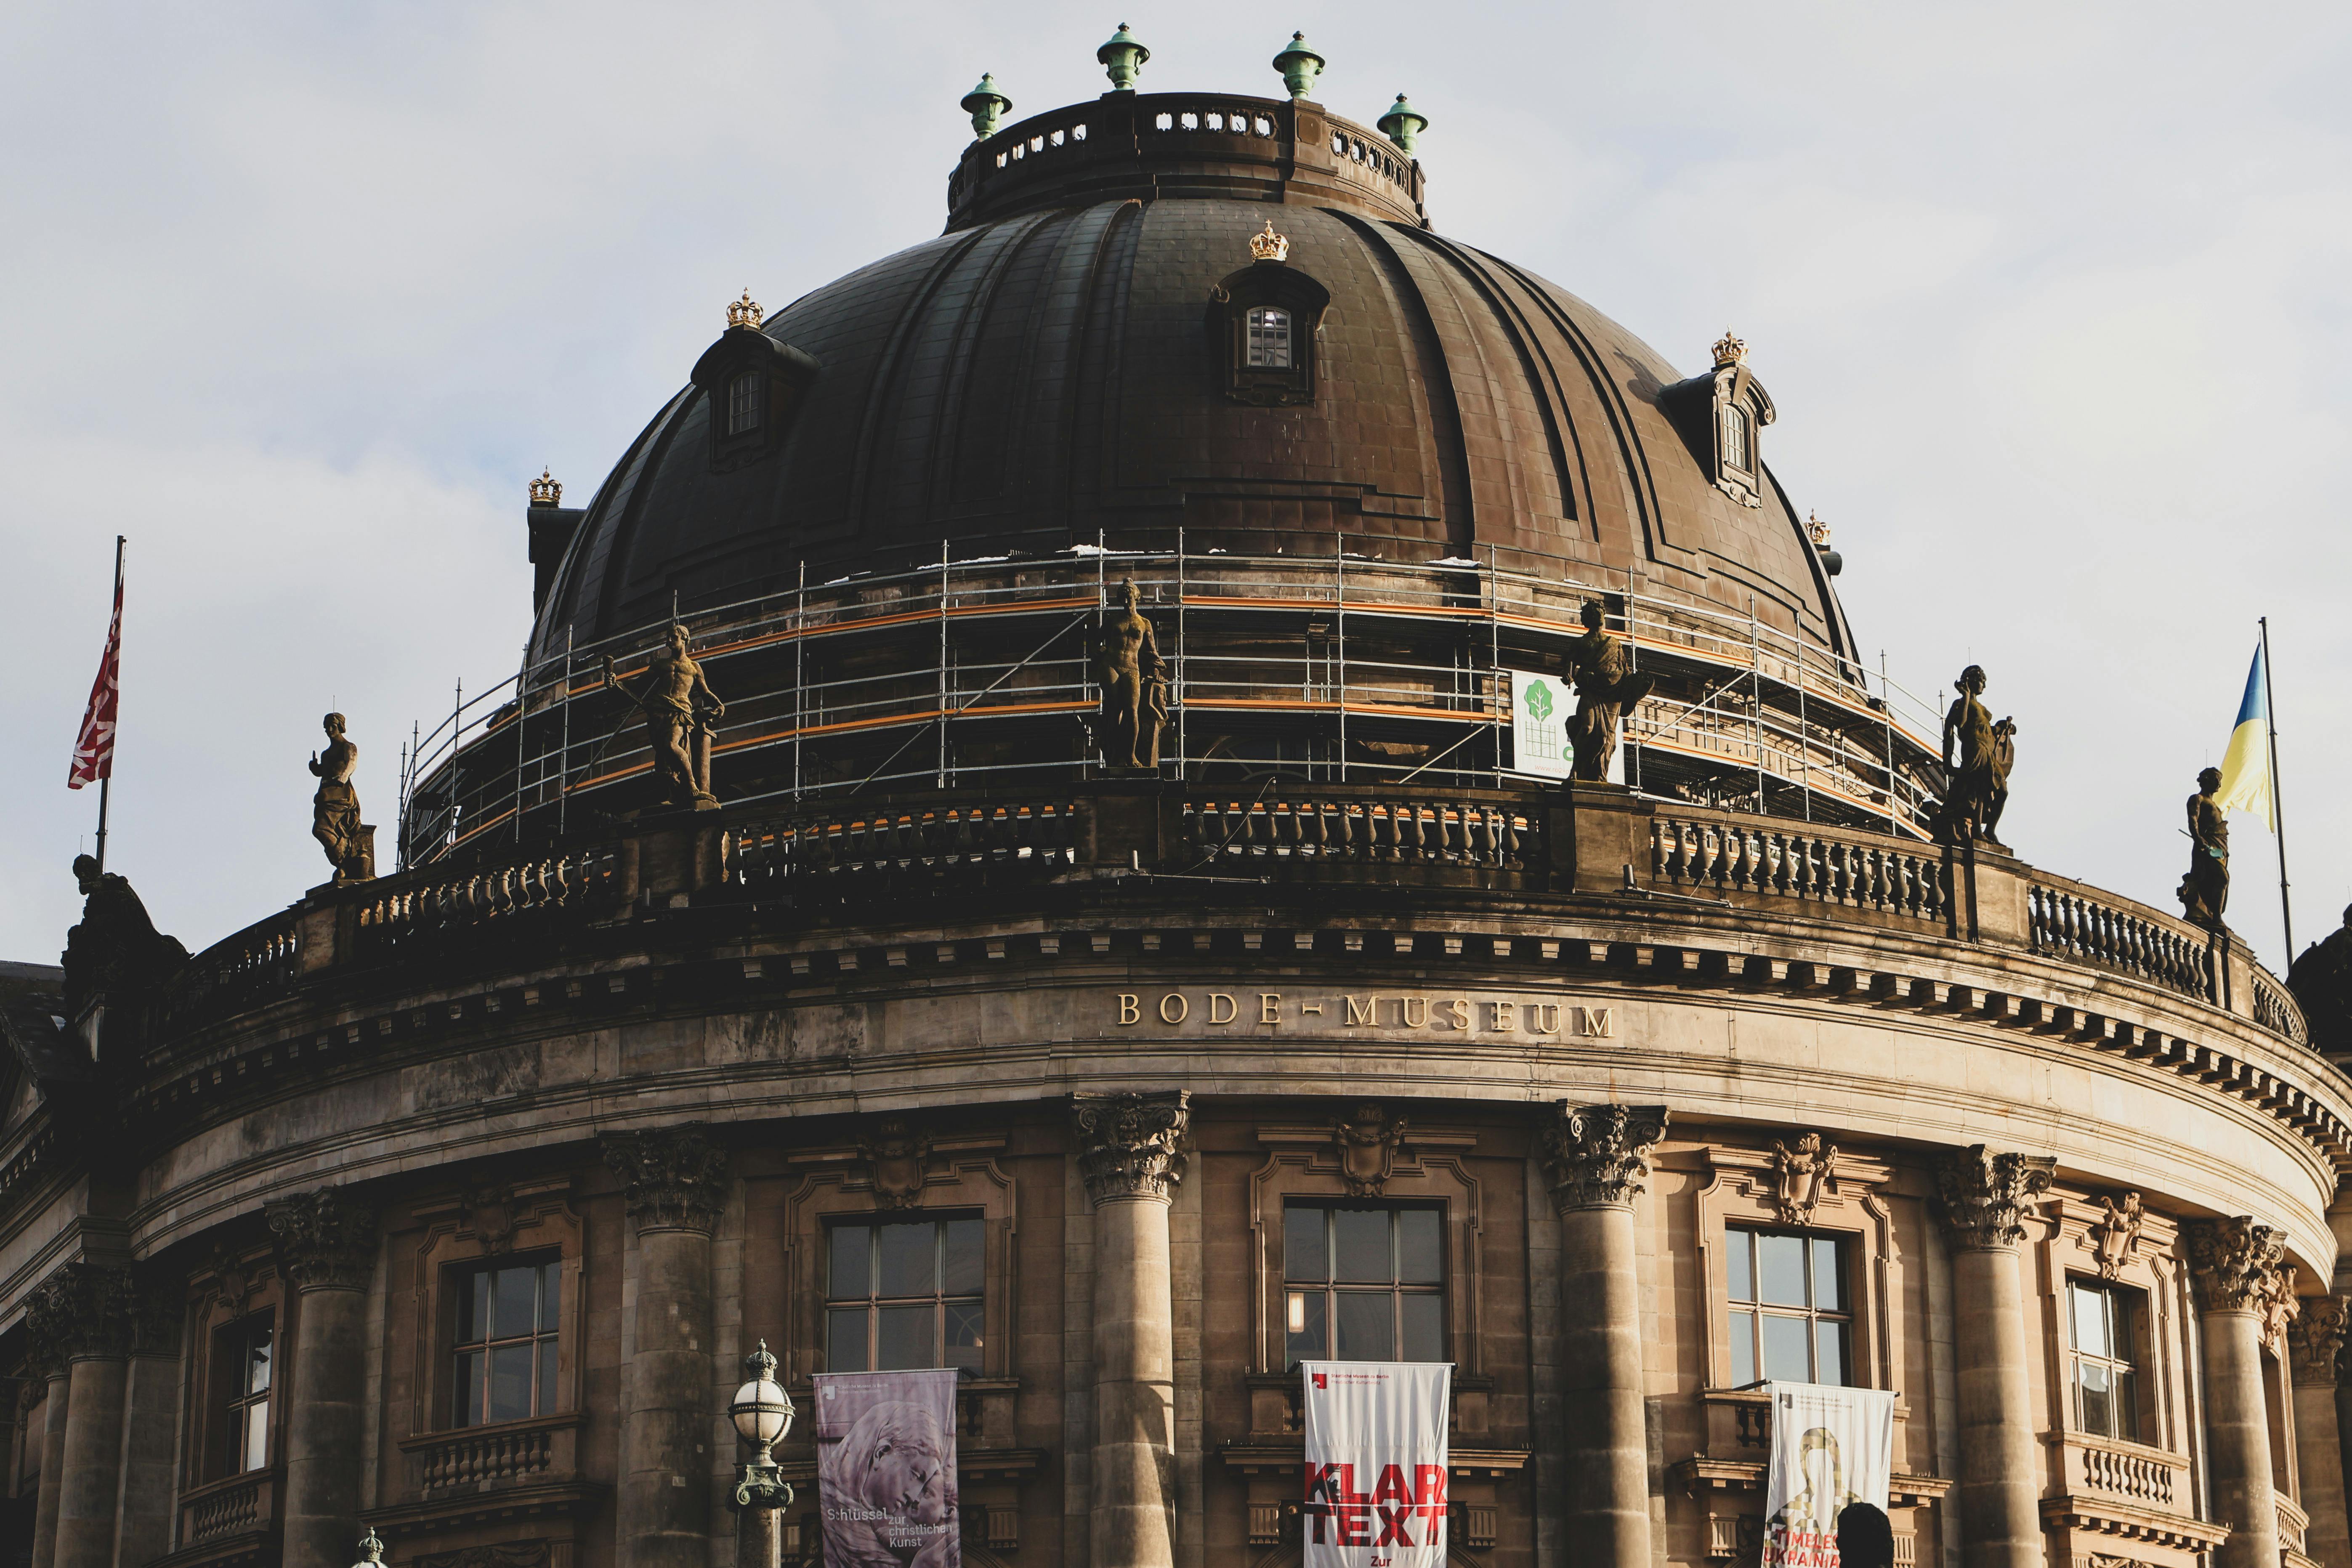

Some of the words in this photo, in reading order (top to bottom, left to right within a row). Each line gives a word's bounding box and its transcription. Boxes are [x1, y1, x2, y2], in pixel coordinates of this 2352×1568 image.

[1117, 993, 1616, 1038] BODE-MUSEUM
[1305, 1462, 1447, 1504] KLAR
[827, 1507, 889, 1521] Schlüssel
[888, 1516, 906, 1525] zur
[889, 1523, 952, 1536] christlichen
[1305, 1504, 1447, 1547] TEXT
[889, 1537, 922, 1548] Kunst
[1775, 1528, 1839, 1550] TIMELES
[1371, 1556, 1392, 1567] Zur
[1764, 1546, 1840, 1568] UKRAINIA
